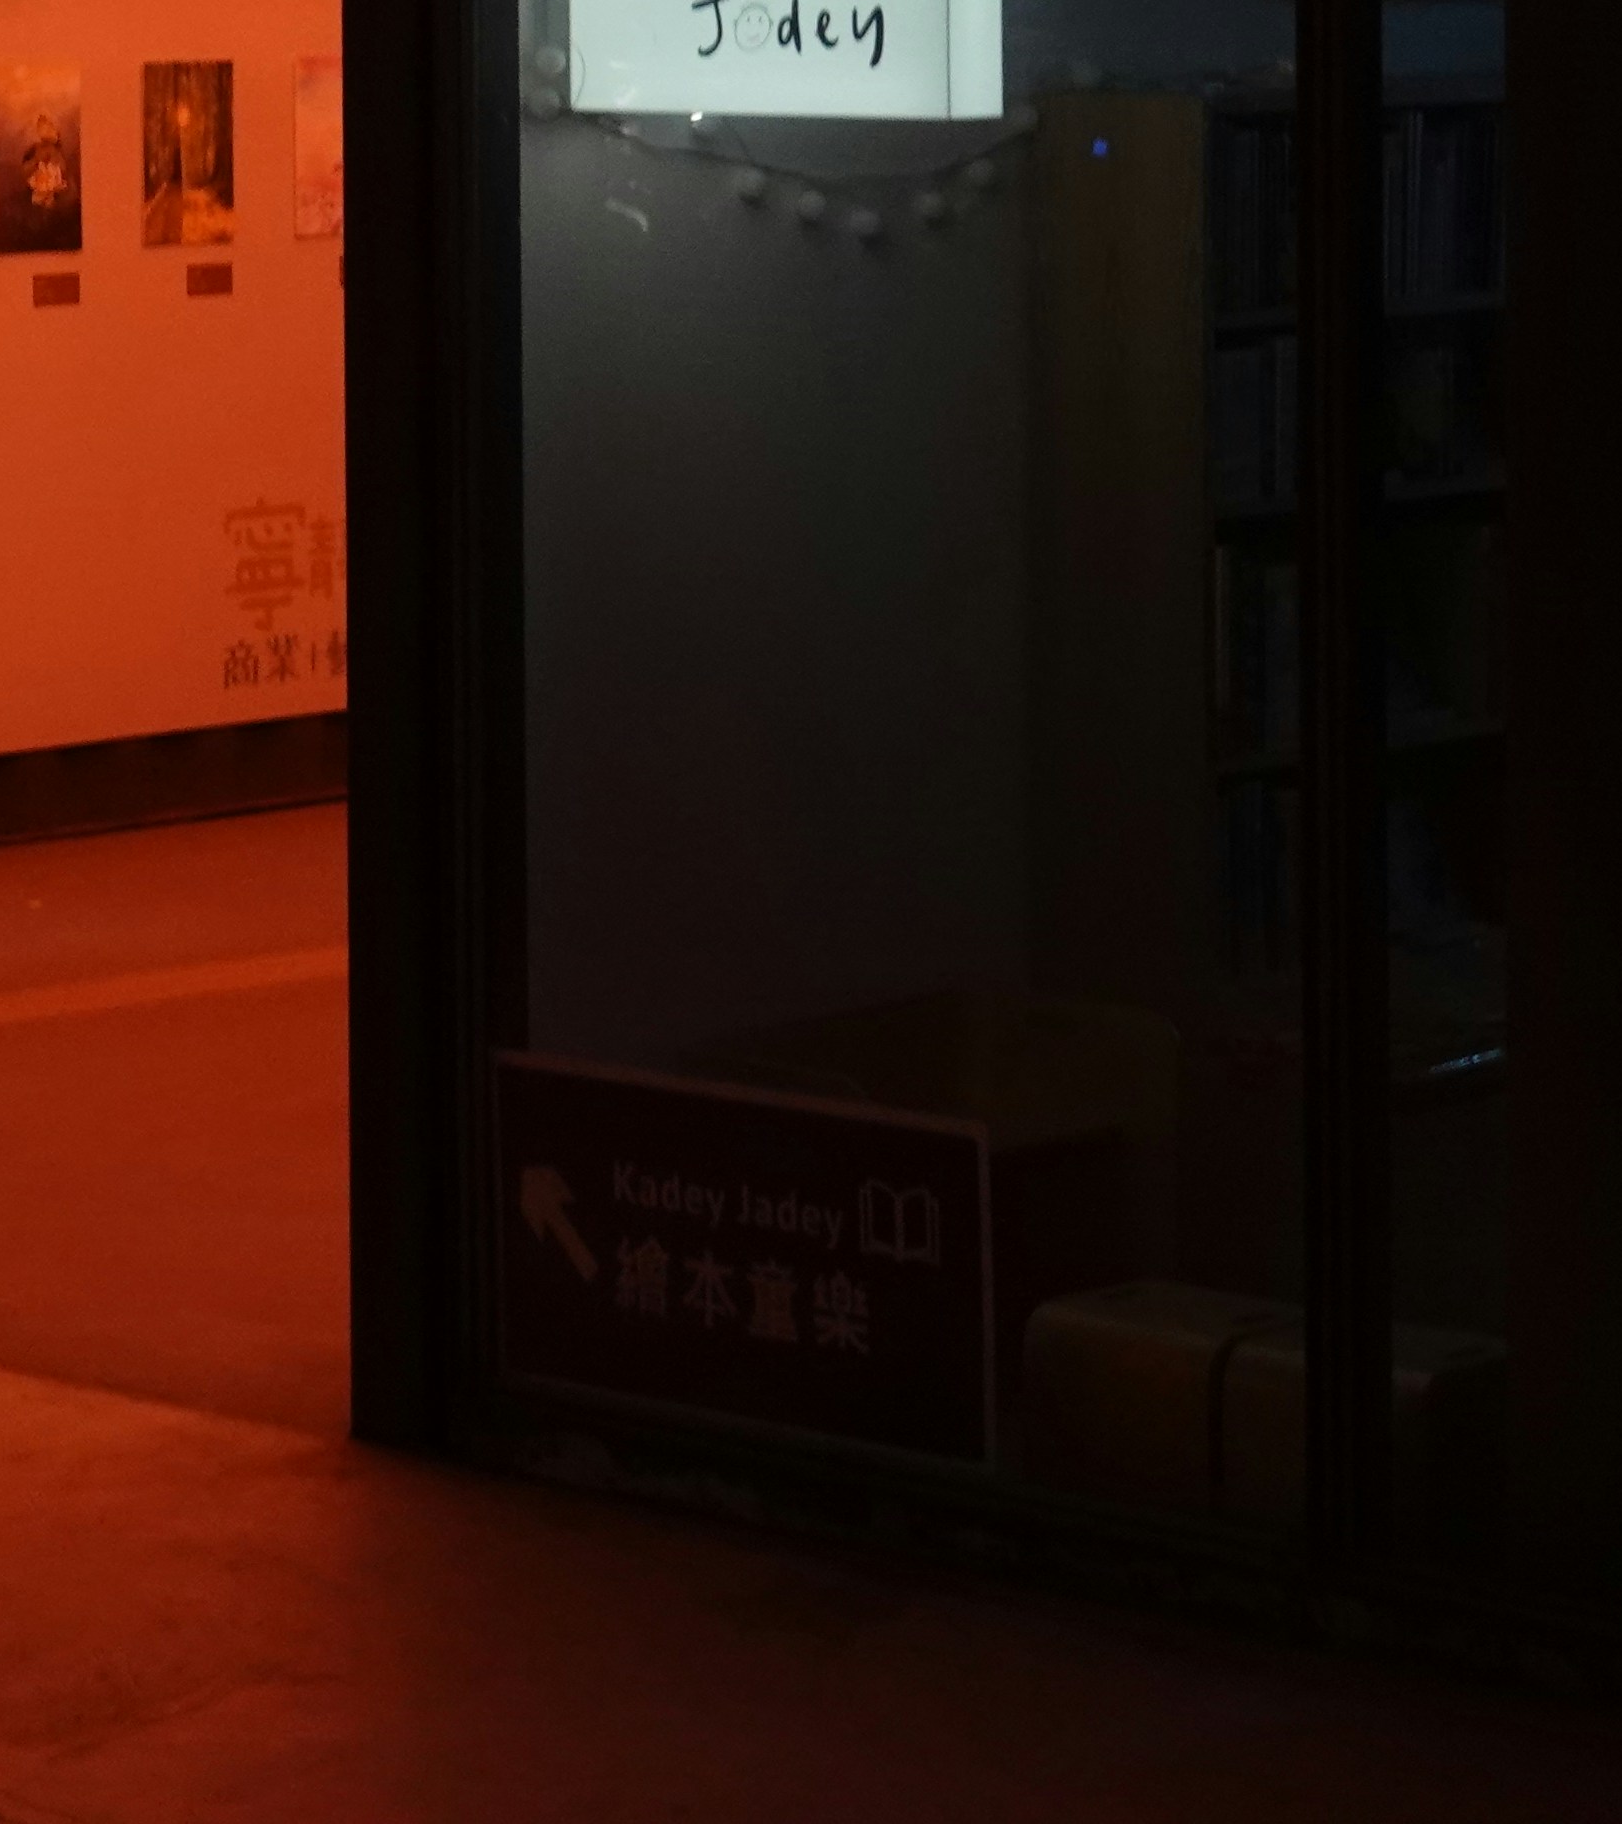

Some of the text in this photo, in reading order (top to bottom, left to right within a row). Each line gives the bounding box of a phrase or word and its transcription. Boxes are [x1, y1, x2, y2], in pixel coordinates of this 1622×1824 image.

[613, 1161, 844, 1249] Kadey Jadey
[614, 1234, 871, 1355] 繪本童樂
